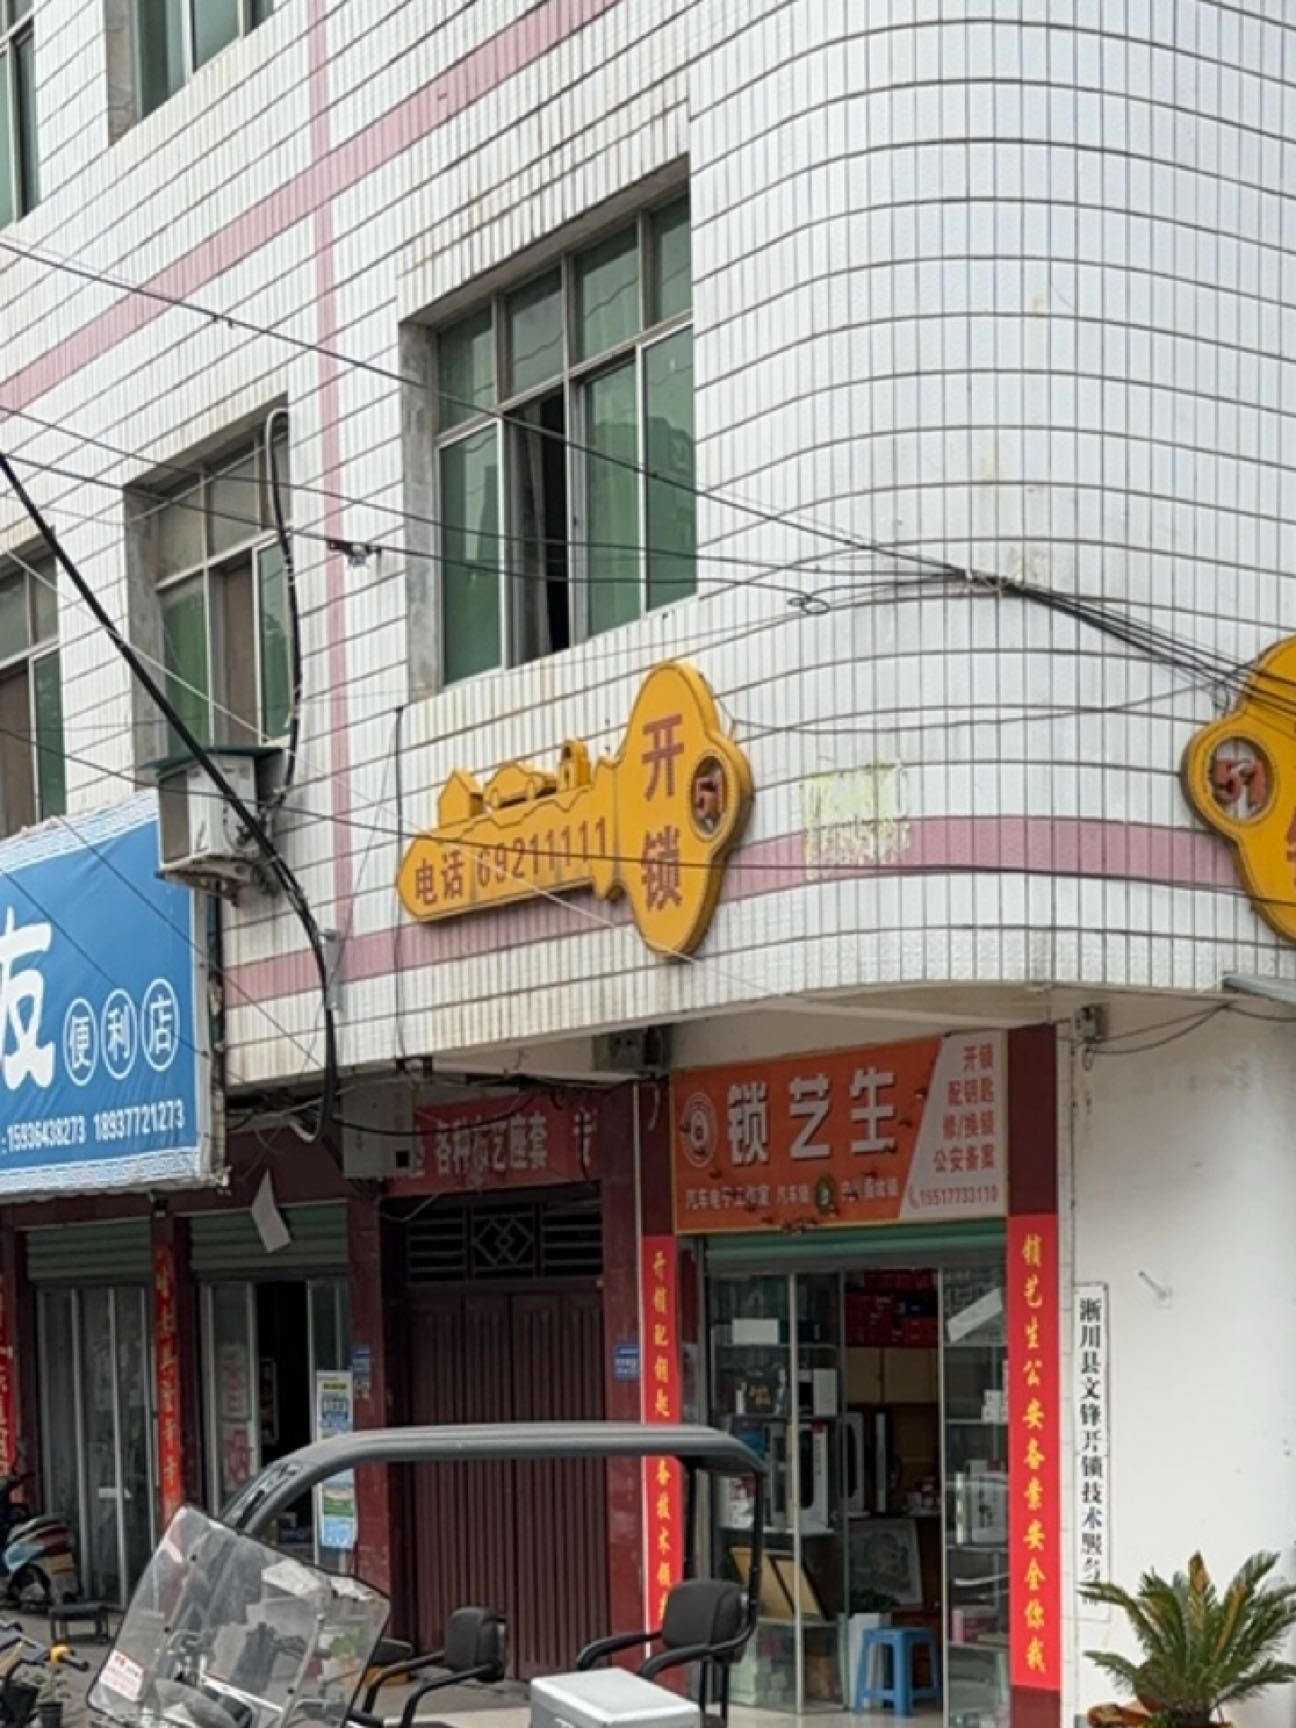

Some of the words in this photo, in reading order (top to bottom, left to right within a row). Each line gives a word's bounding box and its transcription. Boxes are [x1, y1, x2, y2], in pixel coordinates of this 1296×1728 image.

[640, 713, 685, 911] 开锁
[414, 848, 466, 906] 电话
[476, 816, 607, 888] 69211111
[66, 988, 177, 1076] 便利店
[963, 1043, 995, 1072] 开锁
[727, 1065, 898, 1167] 锁艺生
[947, 1077, 995, 1107] 配钥匙
[934, 1143, 995, 1174] 公安备案
